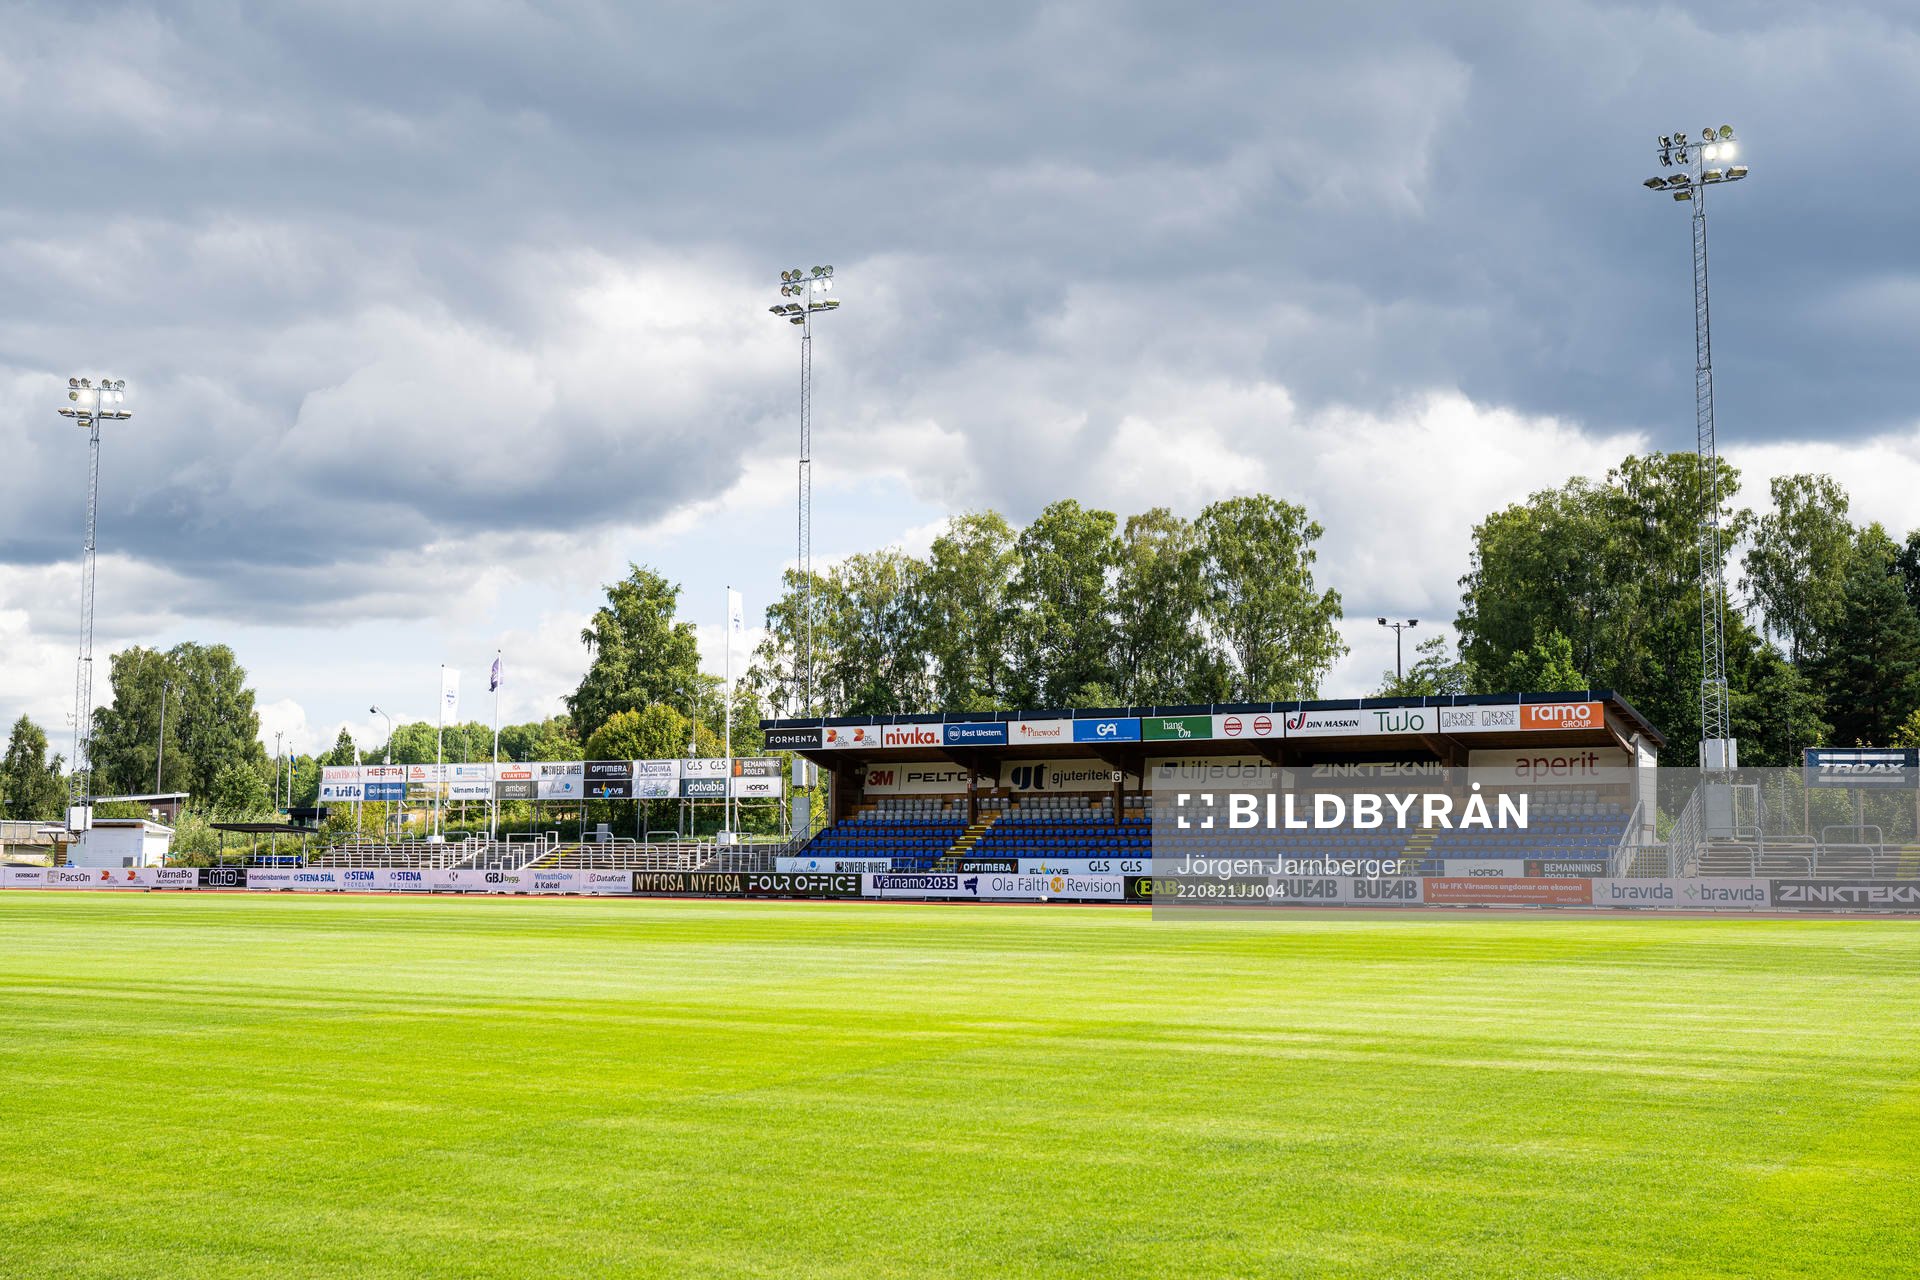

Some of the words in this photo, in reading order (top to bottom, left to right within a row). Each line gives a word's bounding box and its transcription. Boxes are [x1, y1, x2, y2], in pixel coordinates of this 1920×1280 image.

[1451, 711, 1477, 720] KONST
[1491, 710, 1516, 719] KONST
[1531, 704, 1590, 721] ramo
[1163, 720, 1184, 731] hang
[1306, 720, 1322, 729] DIN
[1324, 719, 1359, 728] MASKIN
[1373, 711, 1424, 732] TuJo
[1451, 719, 1476, 727] SMIDE
[1491, 718, 1516, 726] SMIDE
[1561, 720, 1592, 728] GROUP
[961, 729, 975, 737] Best
[1027, 727, 1060, 737] Pinewood
[1096, 723, 1118, 736] GA
[1178, 729, 1191, 738] On
[769, 735, 818, 744] FORMENTA
[686, 761, 703, 770] GLS
[710, 760, 727, 770] GLS
[743, 760, 780, 768] BEMANNINGS
[1515, 752, 1600, 783] aperit
[1818, 763, 1905, 774] TROAX
[367, 768, 404, 776] HESTRA
[549, 765, 565, 776] SWEDE
[566, 765, 582, 775] WHEEL
[743, 767, 765, 775] POOLEN
[868, 770, 894, 786] 3M
[1113, 772, 1120, 781] G
[336, 785, 361, 797] isiflo
[505, 784, 527, 792] amber
[687, 780, 725, 795] golvabia
[844, 861, 865, 873] SWEDE
[867, 861, 888, 873] WHEEL
[1088, 860, 1110, 872] GLS
[1120, 860, 1142, 872] GLS
[1544, 863, 1602, 873] BEMANNINGS
[60, 872, 91, 882] PacsOn
[156, 869, 193, 879] VärnaBo
[250, 873, 290, 881] Handelsbanken
[299, 873, 319, 882] STENA
[320, 872, 336, 882] STÅL
[351, 871, 375, 881] STENA
[397, 871, 422, 881] STENA
[485, 872, 504, 884] GBJ
[596, 874, 626, 882] DataKraft
[635, 873, 685, 891] NYFOSA
[691, 874, 741, 892] NYFOSA
[749, 875, 791, 891] FOUR
[795, 876, 856, 892] OFFICE
[876, 875, 957, 890] Värnamo2035
[992, 877, 1014, 892] Ola
[1018, 876, 1049, 892] Fälth
[1067, 877, 1121, 893] Revision
[1464, 882, 1498, 890] Värnamos
[1500, 883, 1536, 891] ungdomar
[1551, 883, 1582, 891] ekonomi
[1140, 881, 1178, 895] EAB
[1277, 879, 1338, 898] BUFAB
[1353, 879, 1418, 899] BUFAB
[1611, 883, 1673, 899] bravida
[1701, 884, 1765, 901] bravida
